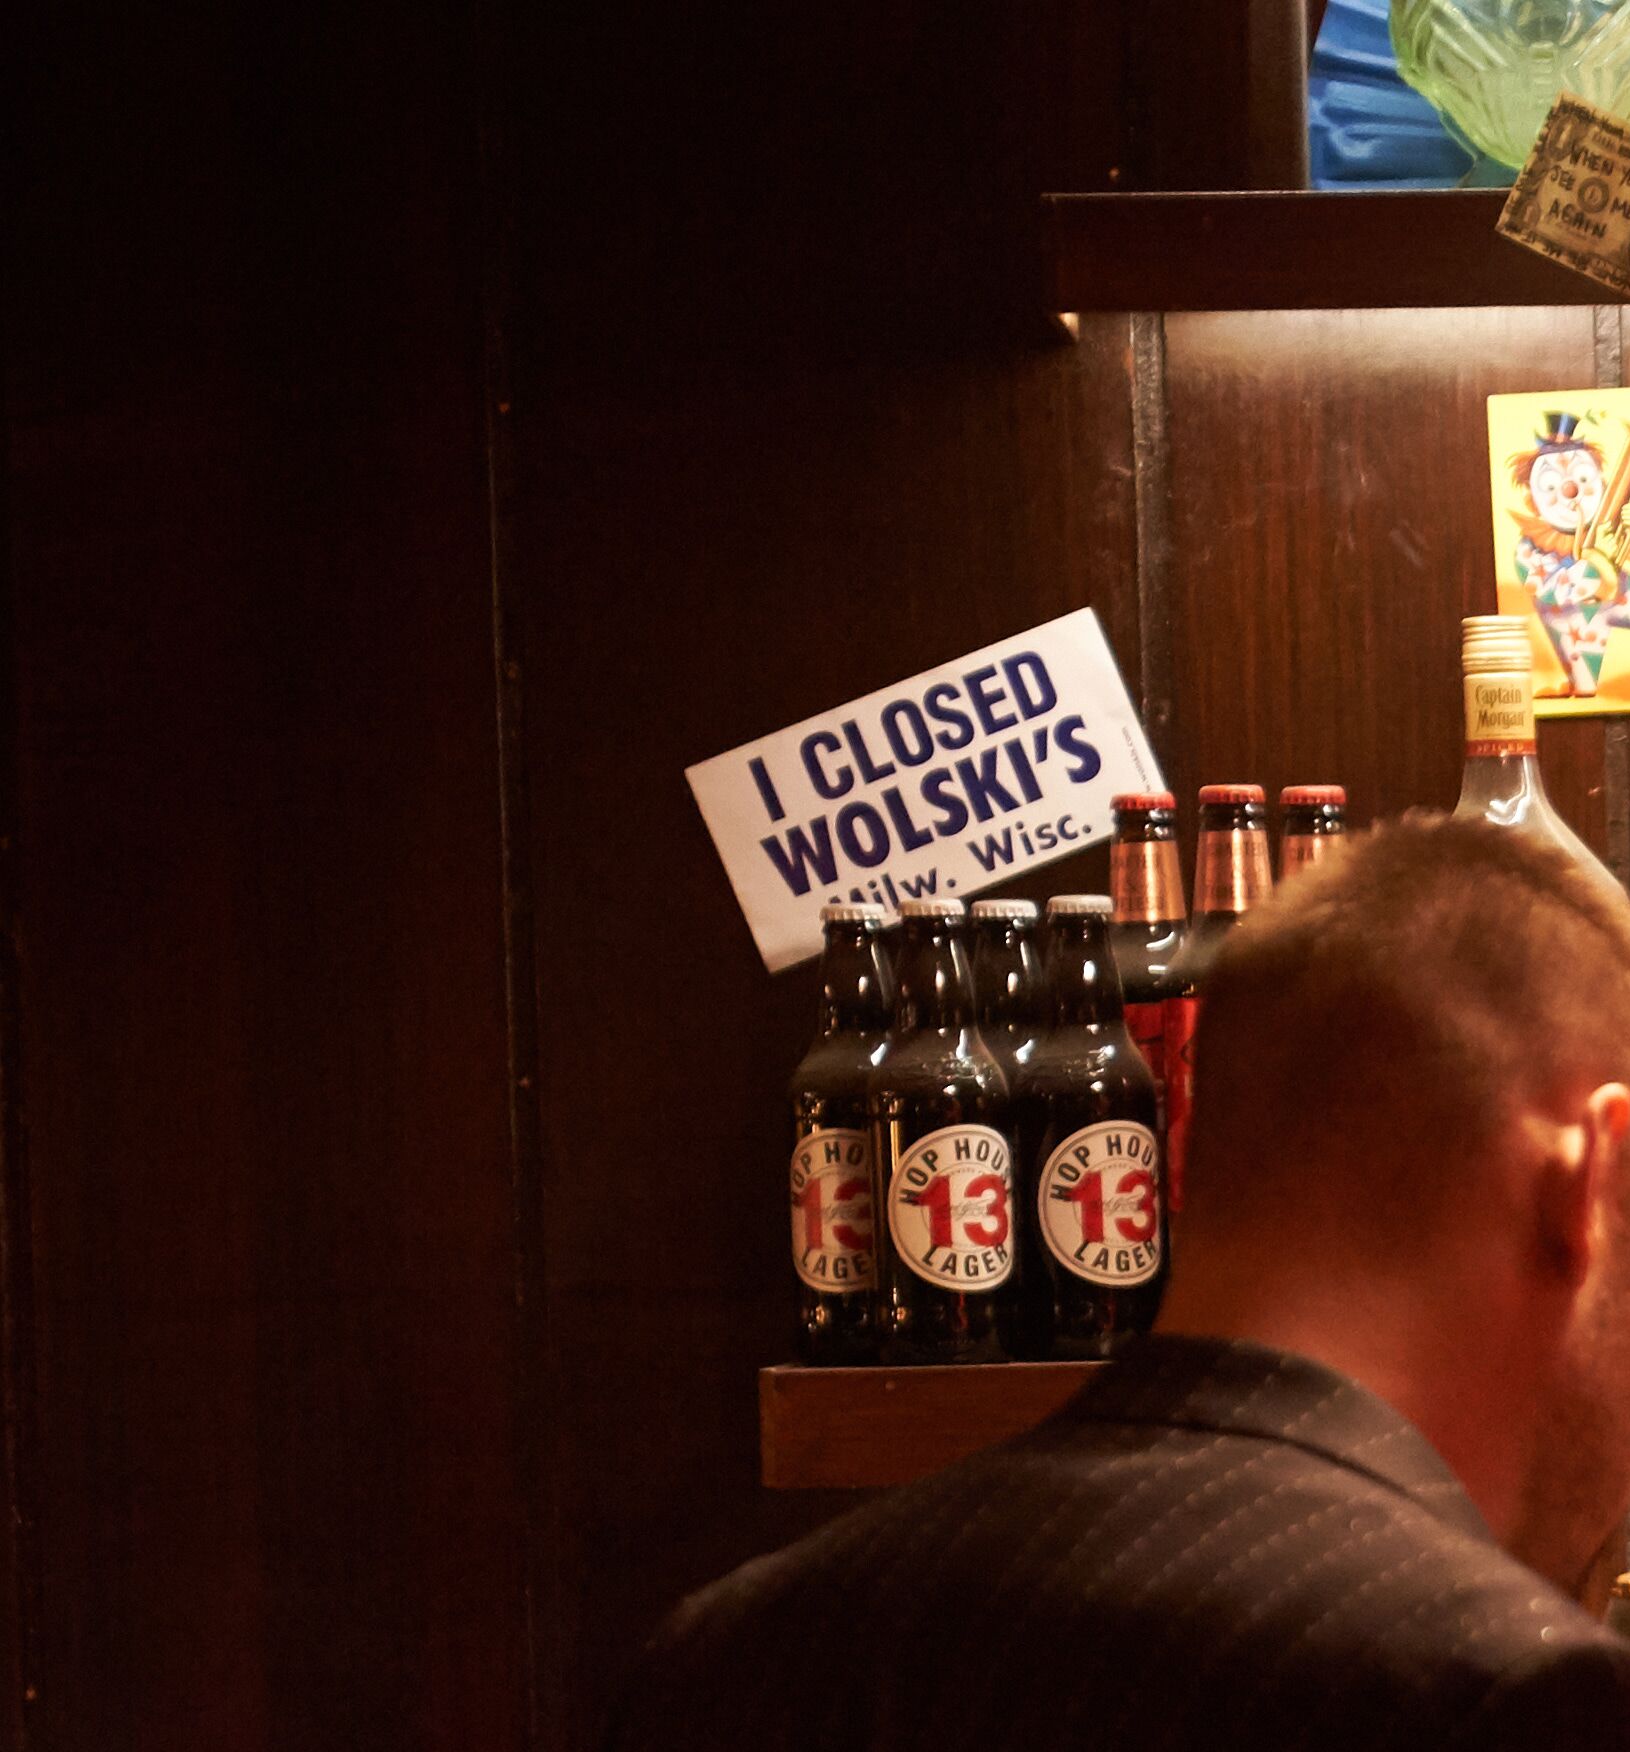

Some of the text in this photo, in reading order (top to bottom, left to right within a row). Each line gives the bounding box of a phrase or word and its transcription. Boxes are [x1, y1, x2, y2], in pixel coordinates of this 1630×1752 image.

[1550, 165, 1577, 192] SEE
[1569, 143, 1615, 177] WHEN
[1549, 197, 1608, 239] AGAIN
[1475, 684, 1522, 708] Captain
[747, 651, 1057, 823] I CLOSED
[1475, 709, 1525, 733] Morgan
[760, 715, 1101, 897] WOLSKI'S
[967, 815, 1093, 872] Wisc.
[900, 1149, 941, 1207] HOP
[954, 1138, 1008, 1178] HOU
[1050, 1134, 1155, 1202] HOP HOU
[795, 1177, 874, 1251] 13
[914, 1174, 1008, 1248] 13
[1068, 1169, 1157, 1243] 13
[802, 1247, 870, 1280] LAGE
[922, 1244, 1009, 1278] LAGER
[1074, 1239, 1157, 1273] LAGER
